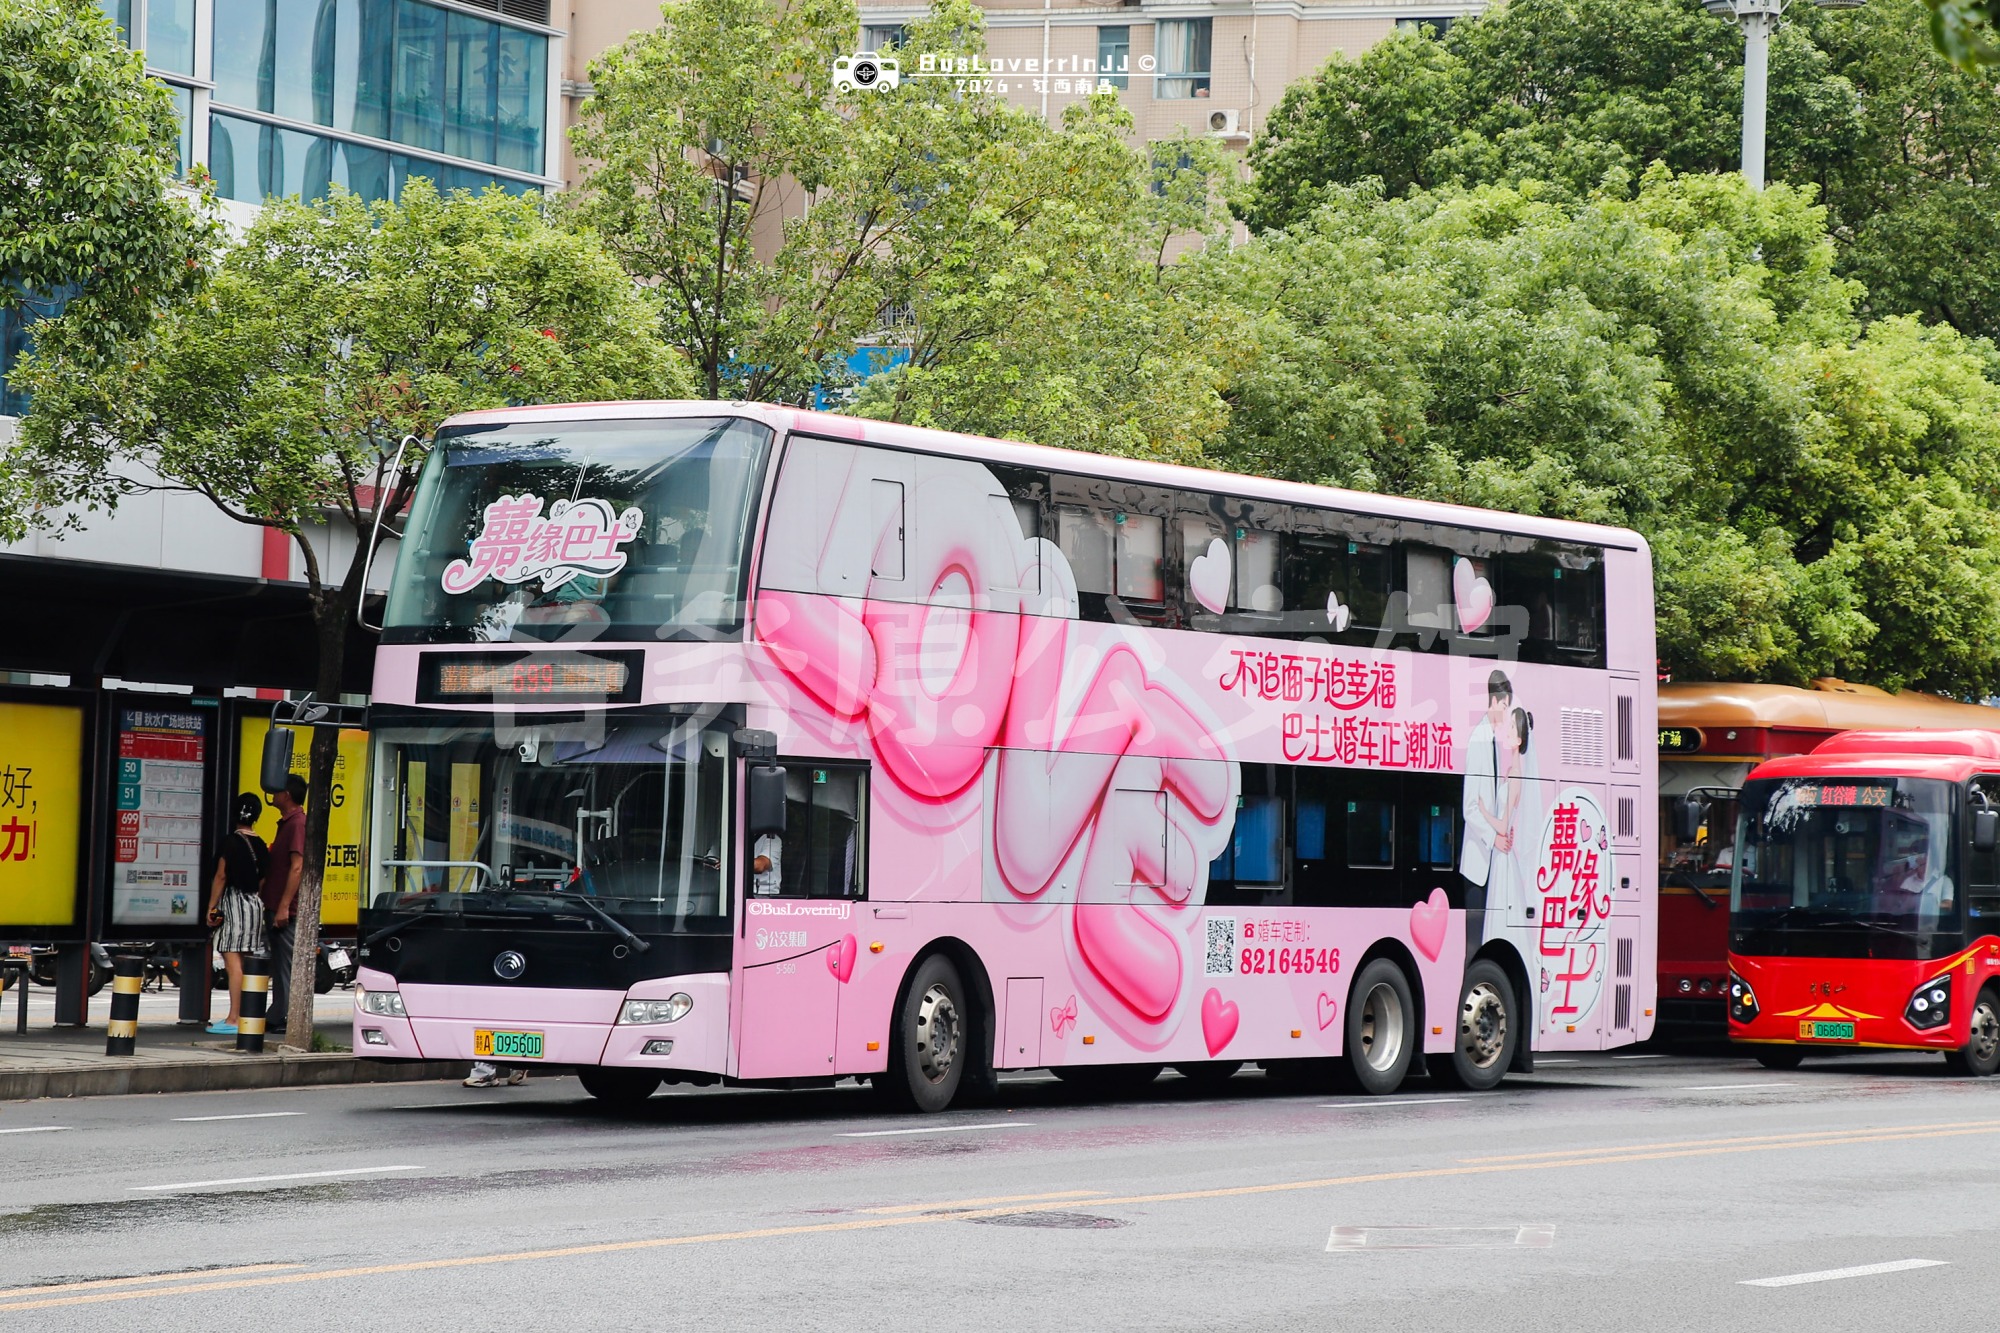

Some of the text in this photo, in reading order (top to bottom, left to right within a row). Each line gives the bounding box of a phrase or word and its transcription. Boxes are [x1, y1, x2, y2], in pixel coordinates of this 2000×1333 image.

[513, 664, 554, 693] 699
[1219, 650, 1396, 710] 不追面子追幸福
[144, 713, 202, 729] 秋水广场地铁站
[1281, 712, 1453, 769] 巴士婚车正潮流
[124, 762, 136, 773] 50
[0, 764, 37, 814] 好，
[124, 787, 134, 799] 51
[1821, 786, 1857, 805] 红谷滩
[1862, 786, 1887, 806] 公交
[121, 812, 139, 825] 699
[119, 838, 136, 849] Y111
[326, 844, 361, 868] 江西
[769, 931, 807, 948] 公交集团
[776, 963, 796, 975] 5-560
[1240, 947, 1341, 975] 82164546
